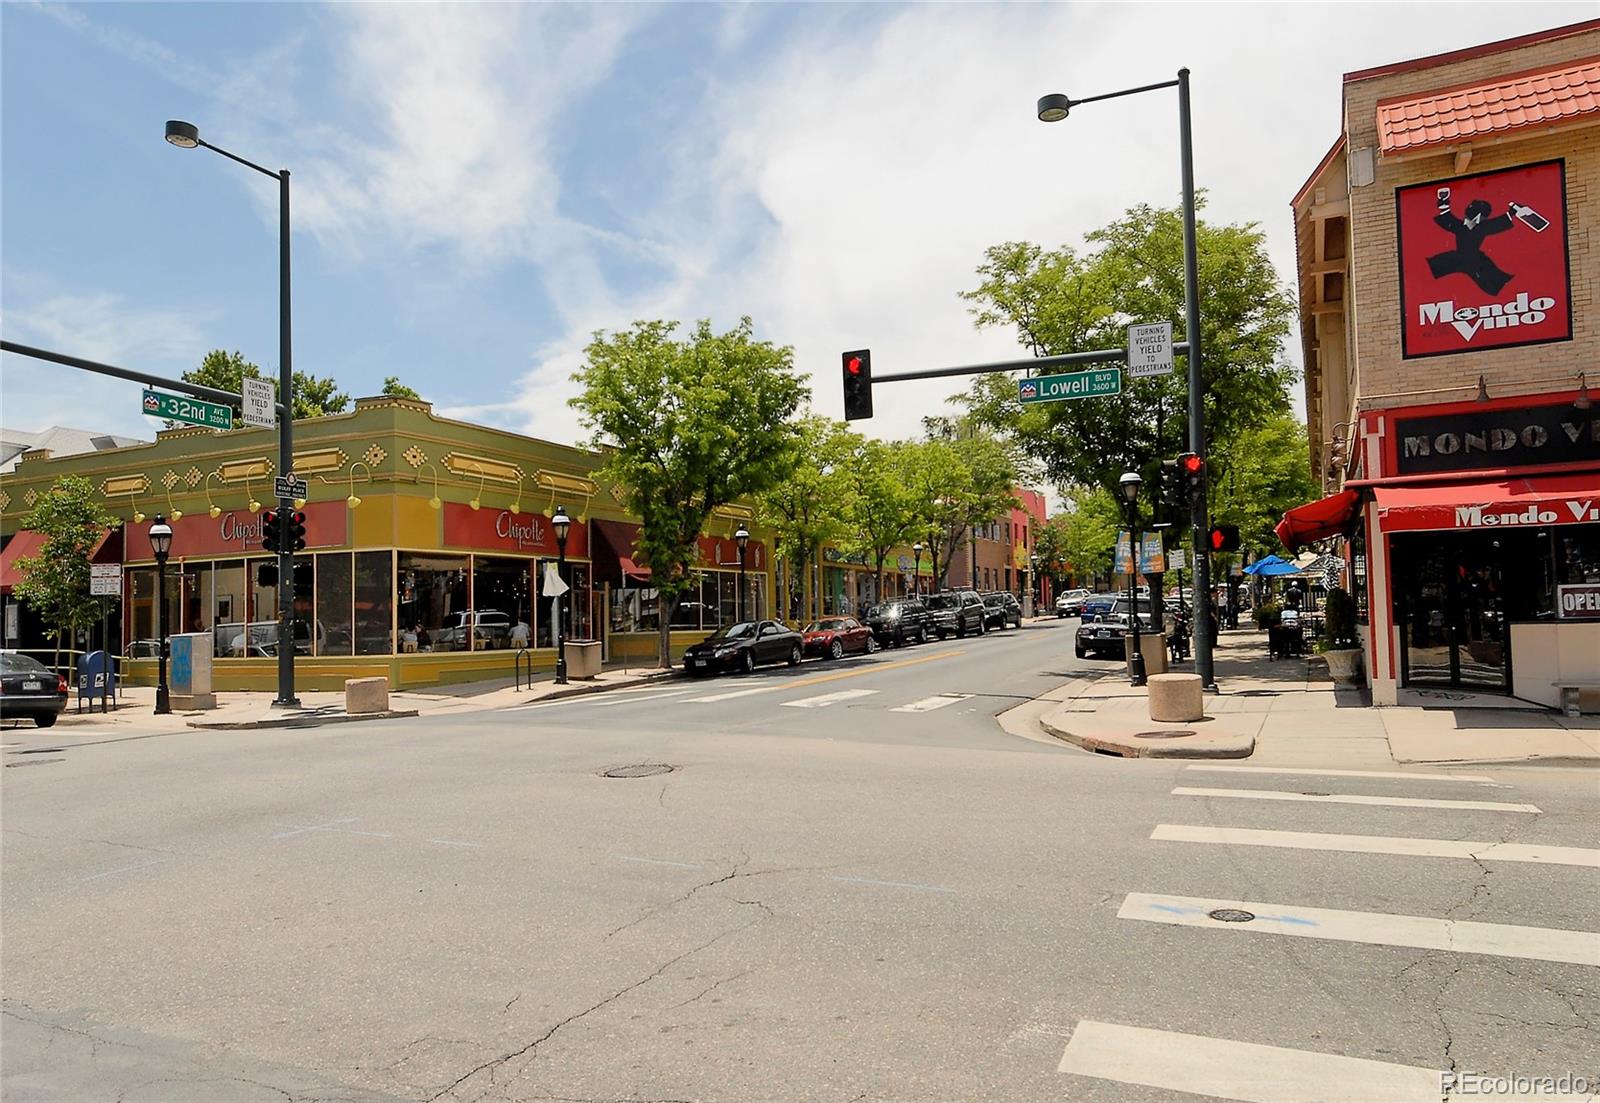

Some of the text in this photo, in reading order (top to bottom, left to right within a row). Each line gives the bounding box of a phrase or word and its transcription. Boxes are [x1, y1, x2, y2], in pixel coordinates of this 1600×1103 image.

[1418, 292, 1557, 327] Mondo
[1137, 326, 1165, 336] TURNING
[1135, 334, 1167, 345] VEHICLES
[1140, 344, 1163, 354] YIELD
[1131, 362, 1172, 374] PEDESTRIANS
[1095, 373, 1112, 382] BLVD
[248, 381, 270, 393] TURNING
[1040, 376, 1090, 397] Lowell
[1092, 382, 1109, 391] 3600
[247, 389, 271, 401] VEHICLES
[250, 398, 269, 409] YIELD
[167, 399, 206, 421] 32nd
[213, 407, 224, 417] AVE
[243, 413, 275, 426] PEDESTRIANS
[1404, 425, 1548, 458] MONDO
[1455, 504, 1559, 527] Mondo
[496, 511, 545, 550] Chipotle
